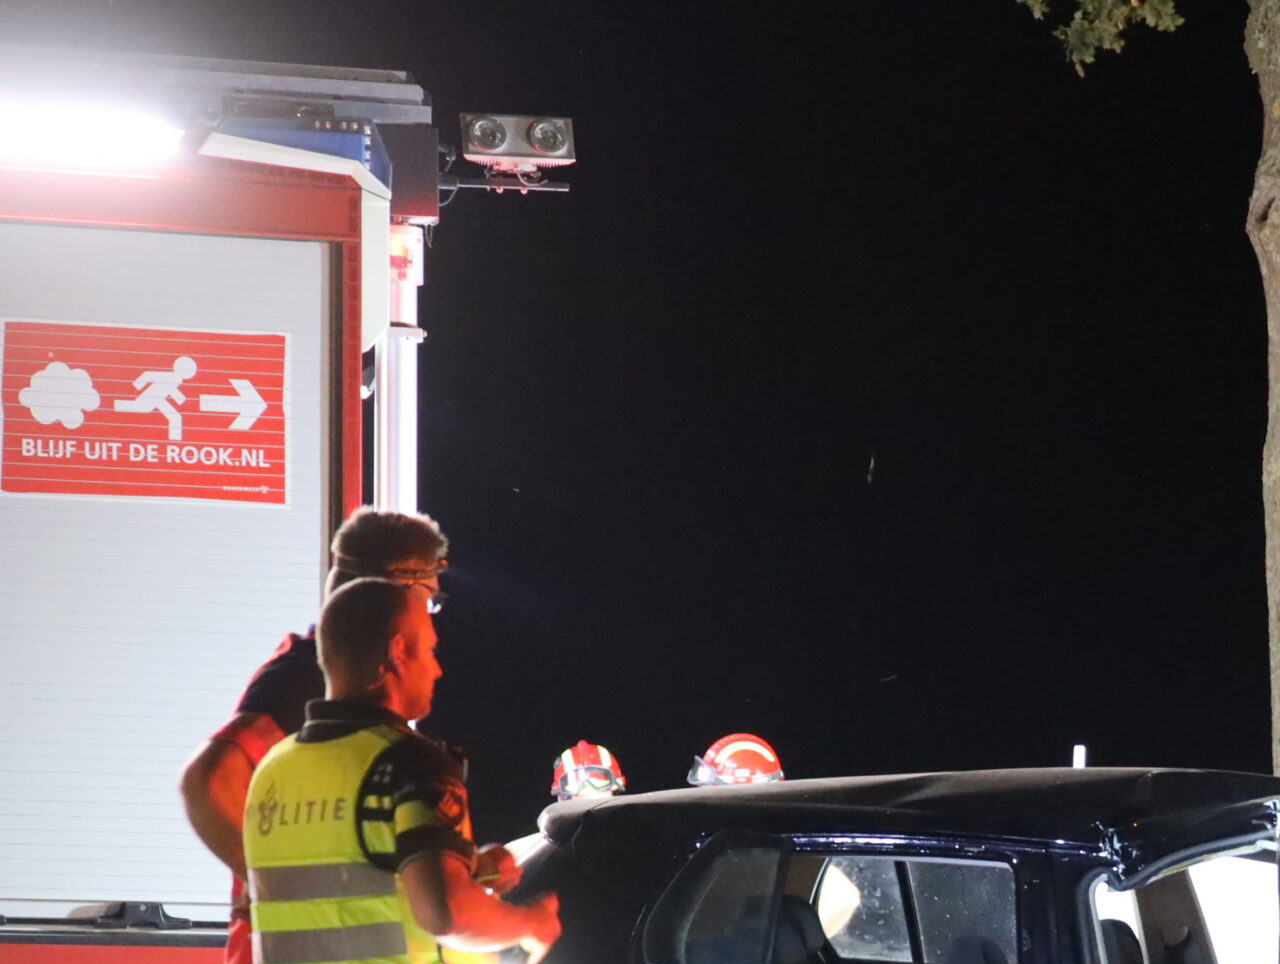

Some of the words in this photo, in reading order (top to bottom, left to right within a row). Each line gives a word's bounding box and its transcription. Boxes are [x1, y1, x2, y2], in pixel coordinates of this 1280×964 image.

[22, 438, 77, 458] BLIJF
[84, 441, 122, 460] UIT
[129, 443, 159, 462] DE
[166, 445, 271, 467] ROOK.NL
